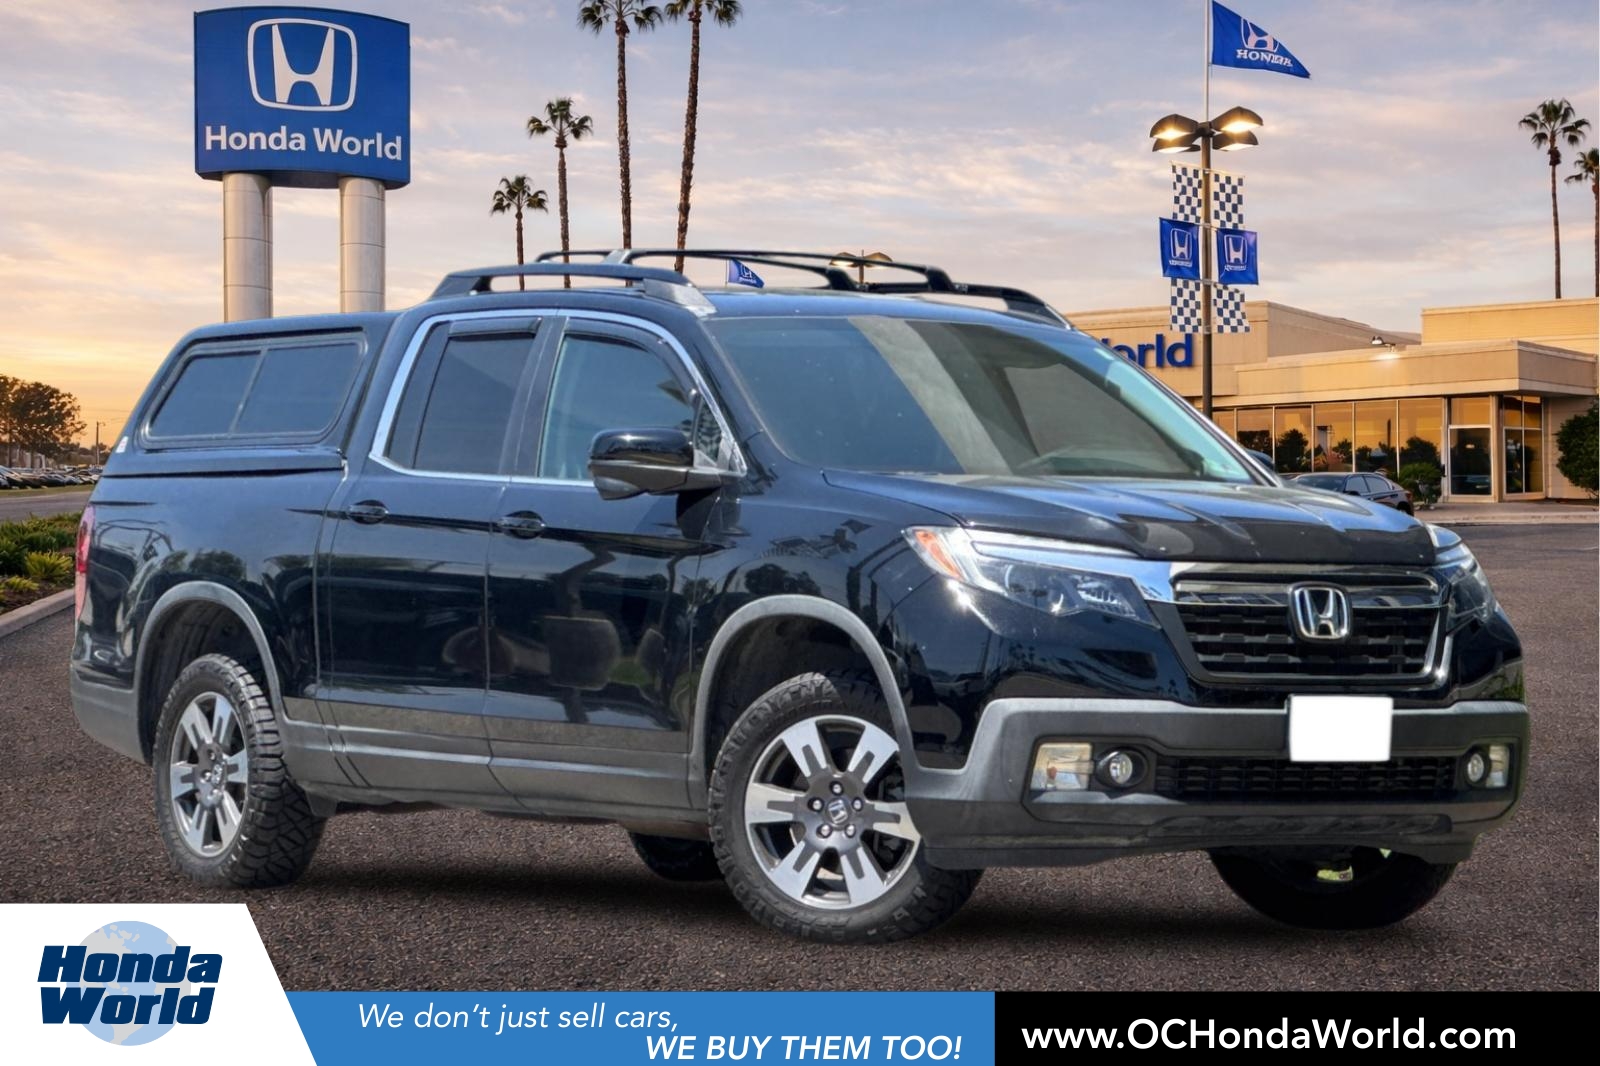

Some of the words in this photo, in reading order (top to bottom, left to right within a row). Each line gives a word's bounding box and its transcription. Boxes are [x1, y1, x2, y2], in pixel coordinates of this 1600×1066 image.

[205, 125, 306, 151] Honda
[313, 127, 402, 161] World
[1101, 333, 1193, 368] orld
